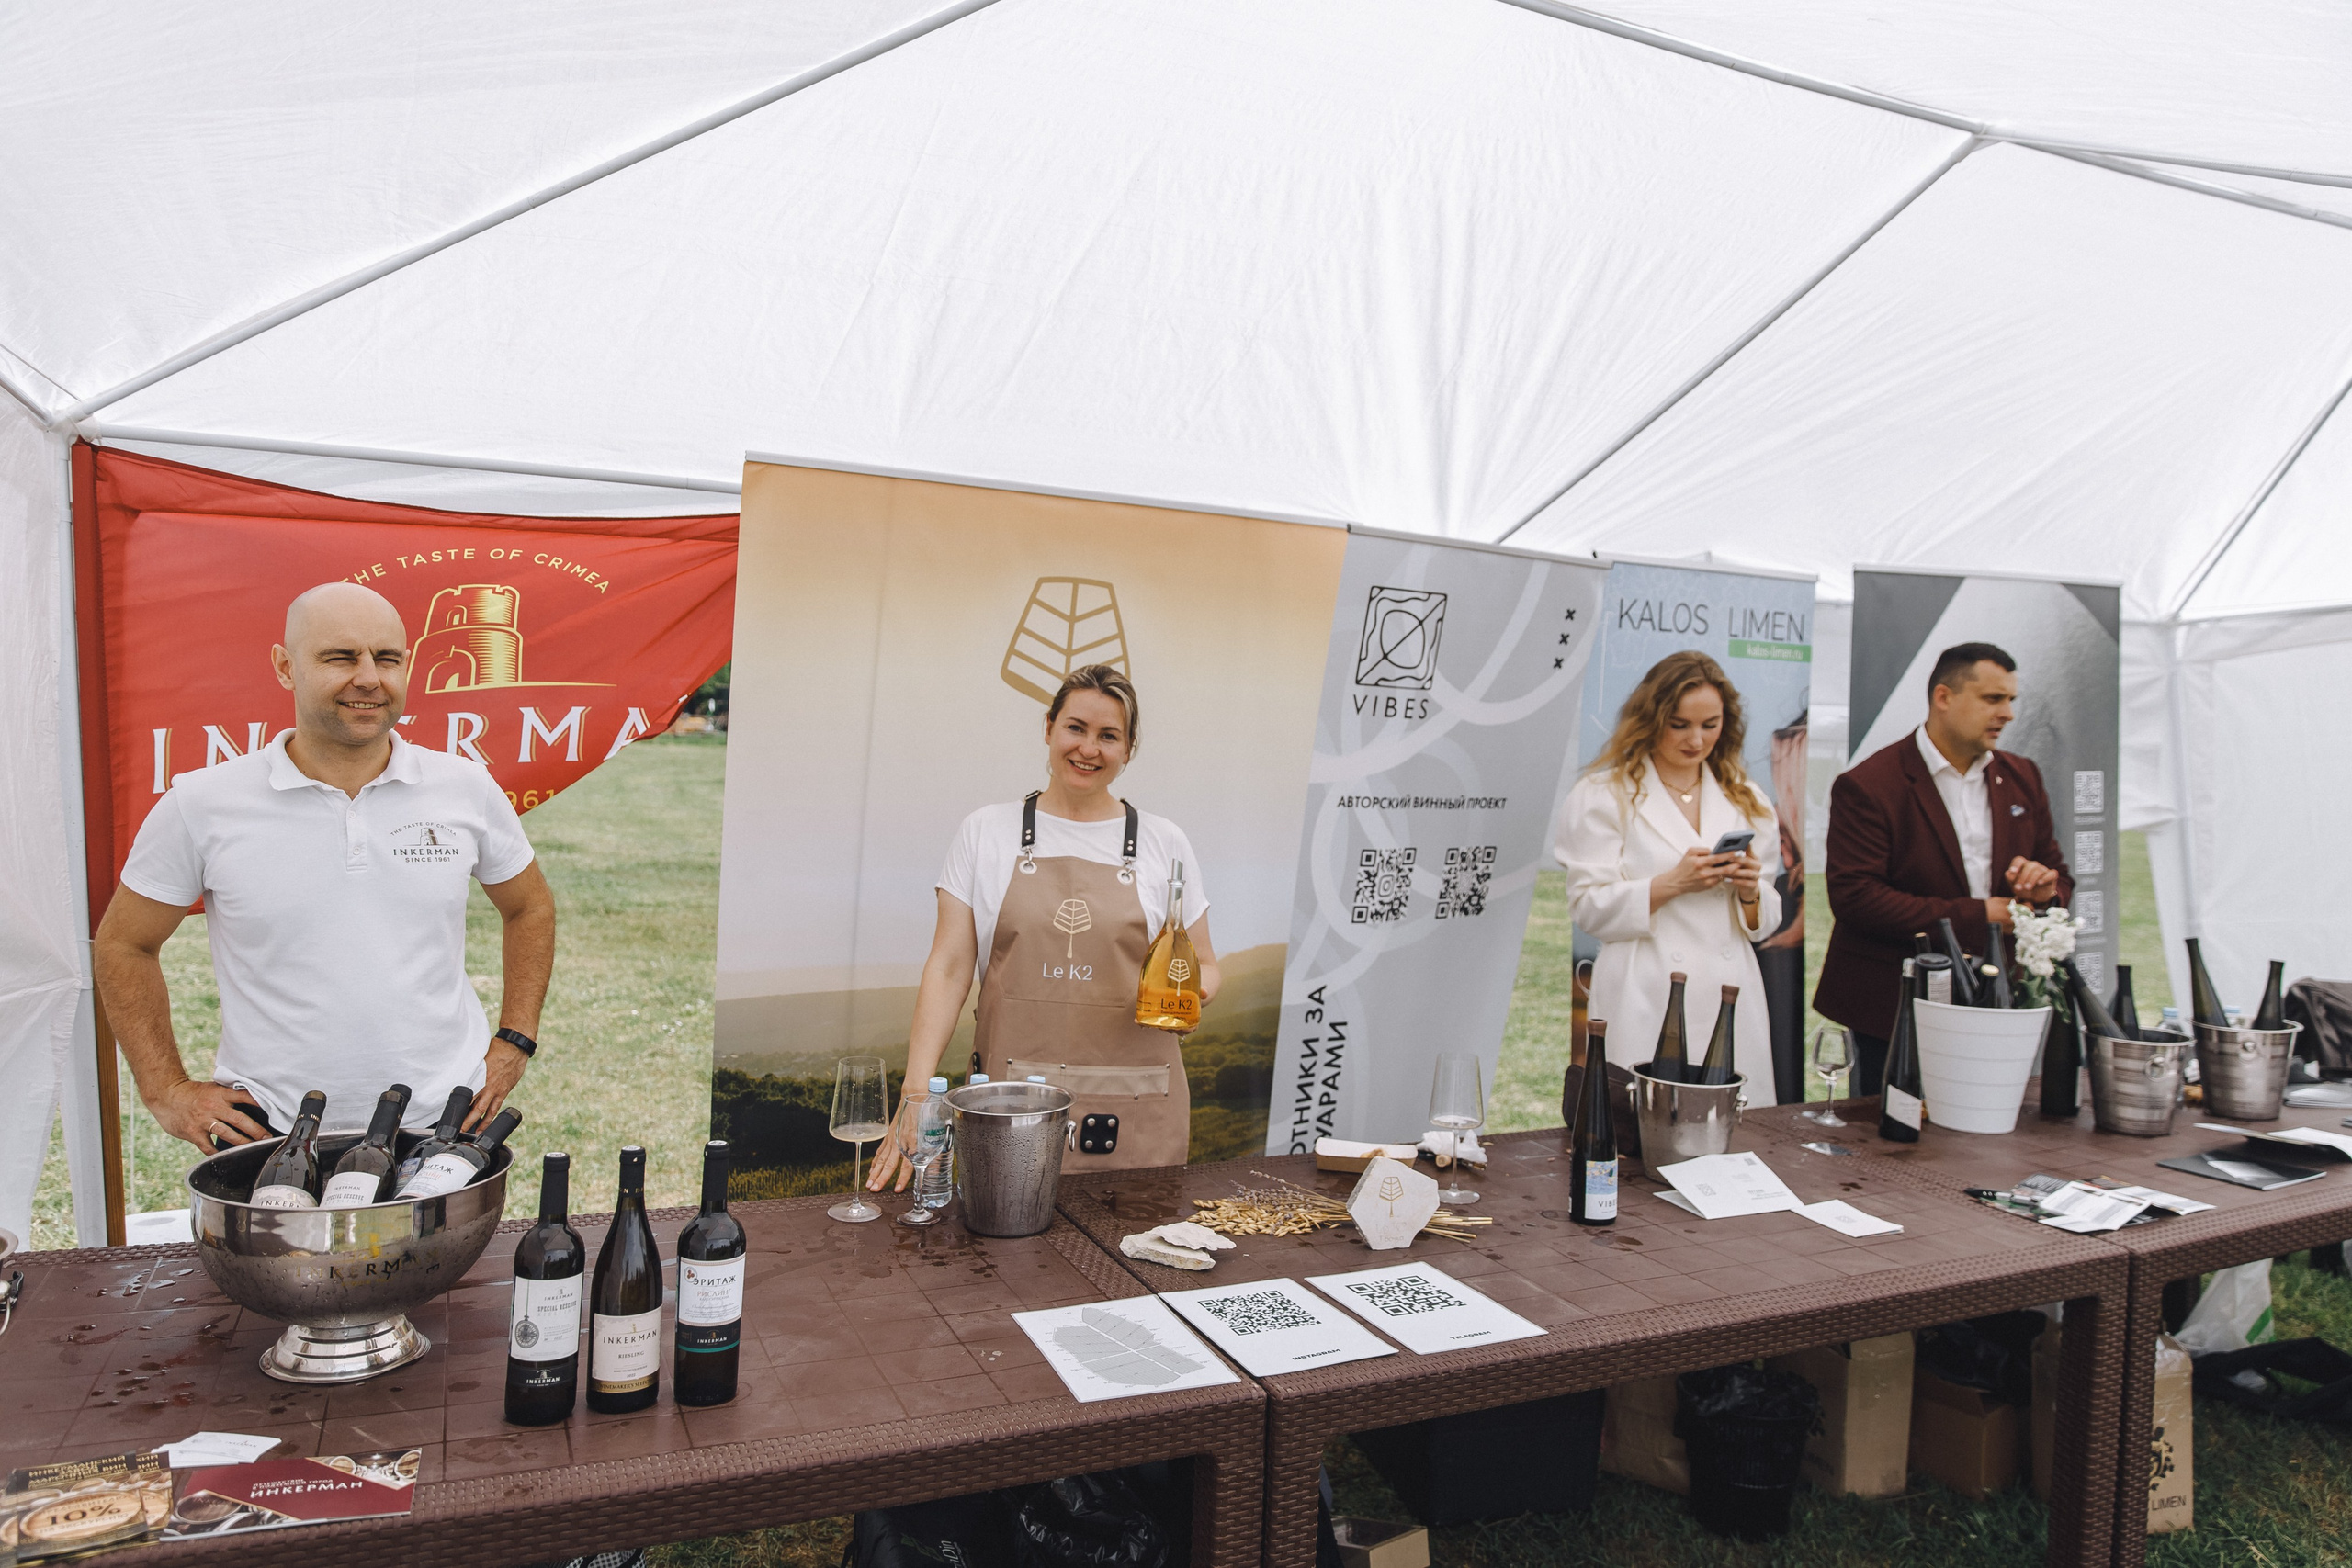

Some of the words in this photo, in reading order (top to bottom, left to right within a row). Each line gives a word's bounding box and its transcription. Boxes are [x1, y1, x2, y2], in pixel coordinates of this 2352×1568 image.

[397, 548, 476, 569] TASTE
[490, 548, 523, 560] OF
[534, 553, 610, 594] CRIMEA
[1618, 598, 1709, 636] KALOS
[1729, 606, 1805, 643] LIMEN
[1353, 694, 1430, 719] VIBES
[1337, 794, 1411, 809] АВТОРСКИЙ
[1413, 795, 1465, 809] ВИННЫЙ
[1466, 796, 1508, 810] ПРОЕКТ
[1043, 963, 1064, 978] Le
[1069, 964, 1093, 980] K2
[1160, 998, 1175, 1010] Le
[1178, 999, 1193, 1010] K2
[1305, 984, 1327, 1023] ЗА
[1312, 1021, 1348, 1151] УАРАМИ
[261, 1200, 300, 1208] INKER
[693, 1275, 737, 1286] ЭРИТАЖ
[544, 1292, 574, 1301] INKERMAN
[697, 1288, 731, 1297] РИСЛИНГ
[537, 1304, 558, 1313] SPECIAL
[560, 1300, 577, 1310] RESERVE
[603, 1329, 658, 1344] INKERMAN
[1450, 1330, 1492, 1340] TELEGRAM
[1292, 1348, 1340, 1361] INSTAGRAM
[526, 1376, 560, 1384] INKERMAN
[250, 1481, 363, 1498] ИНКЕРМАН
[2151, 1495, 2187, 1511] LIMEN
[47, 1503, 121, 1526] 10%
